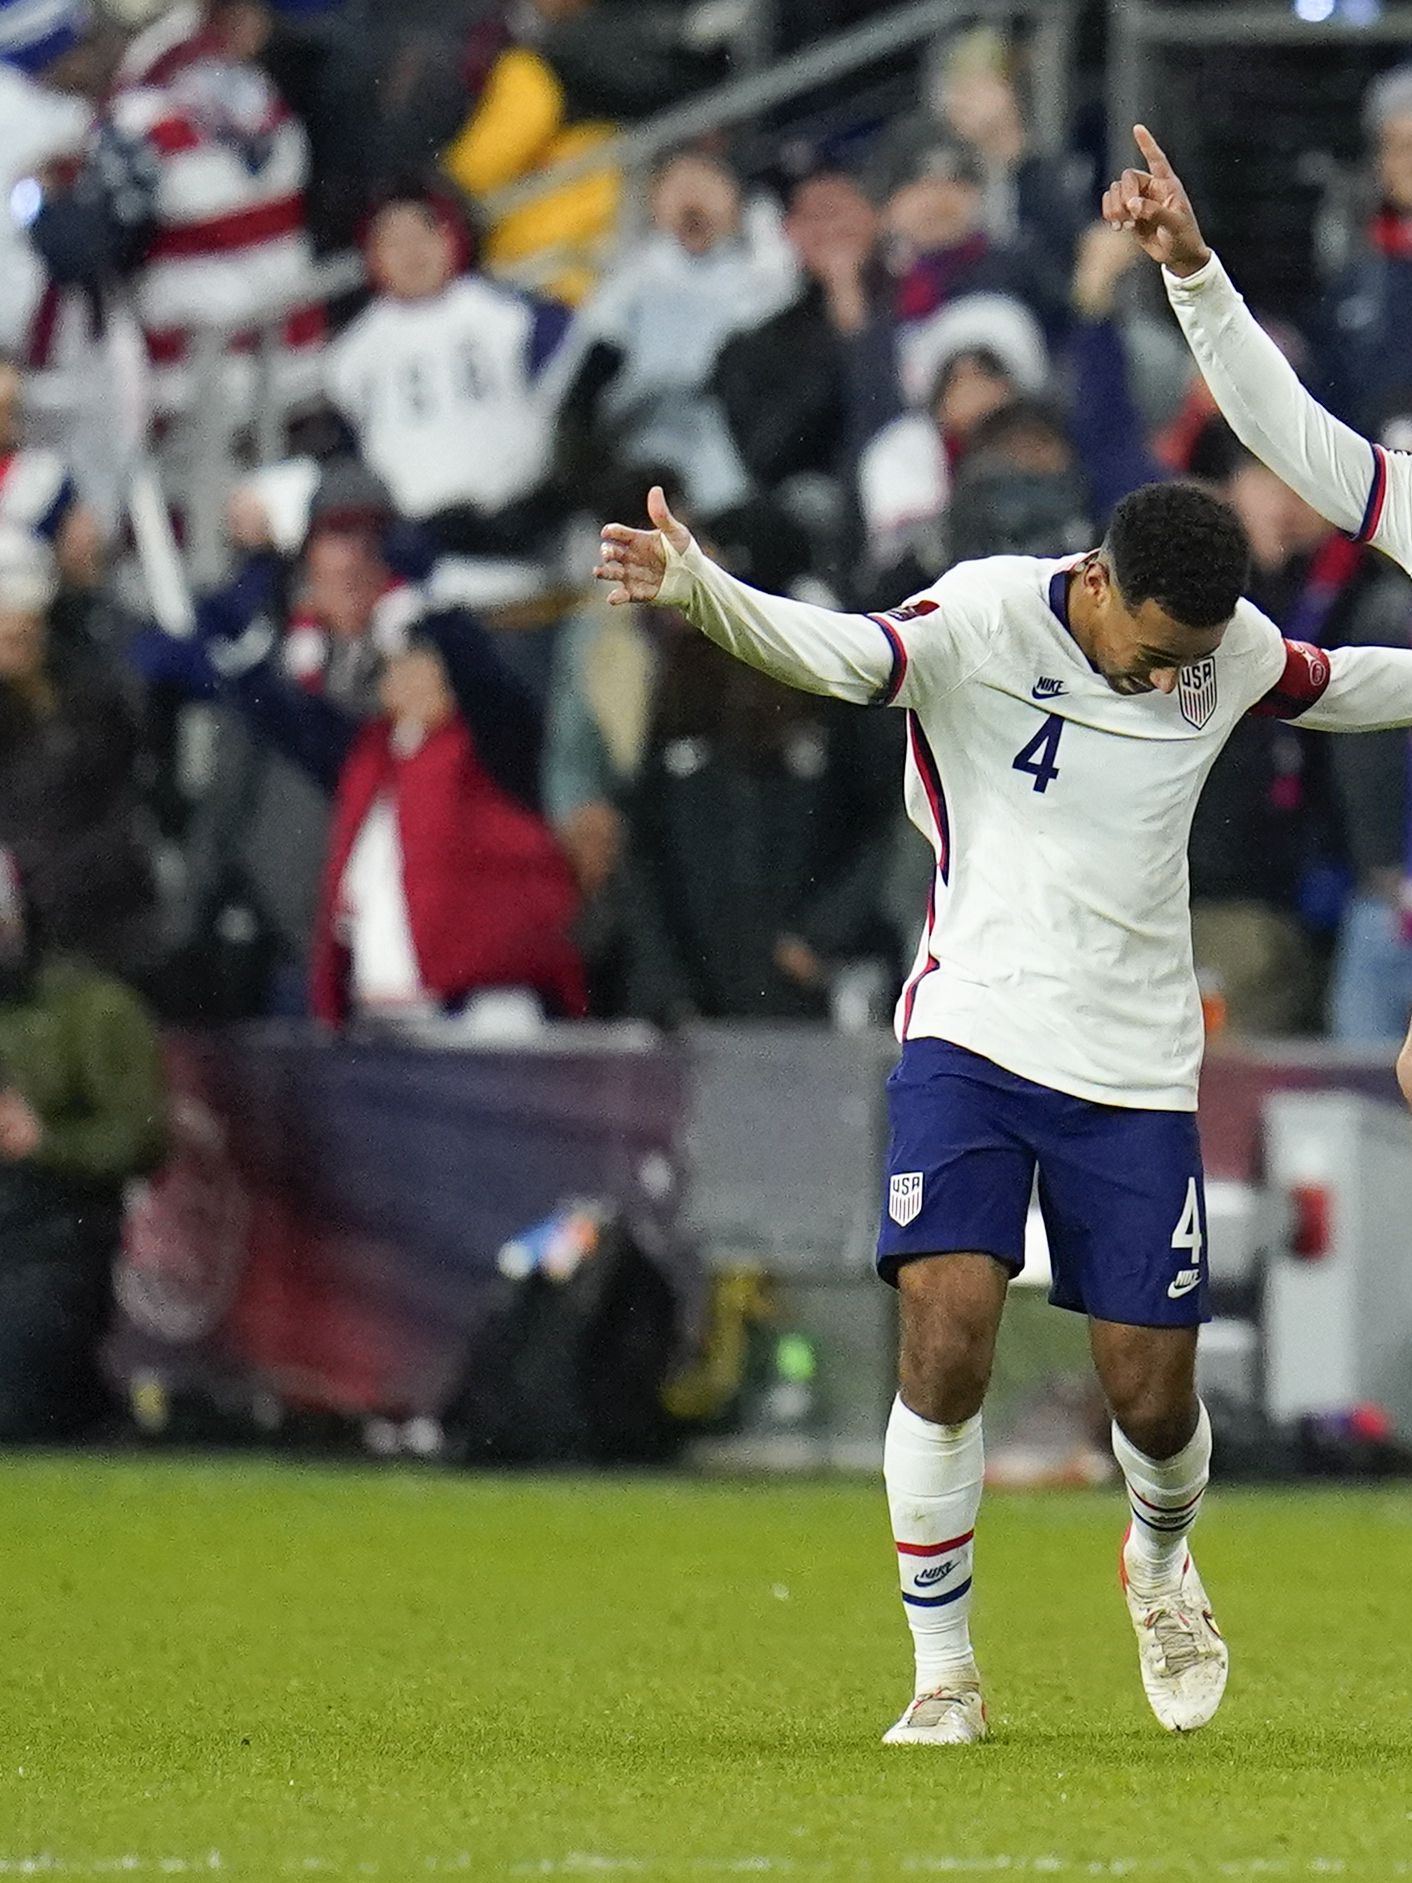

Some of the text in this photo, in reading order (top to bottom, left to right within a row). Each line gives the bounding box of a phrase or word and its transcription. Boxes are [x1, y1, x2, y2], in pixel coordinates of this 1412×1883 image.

[1037, 676, 1064, 694] NIKE
[1181, 662, 1212, 690] USA
[1012, 713, 1065, 794] 4
[893, 1176, 920, 1195] USA
[1171, 1177, 1203, 1264] 4
[920, 1560, 954, 1578] NIKE
